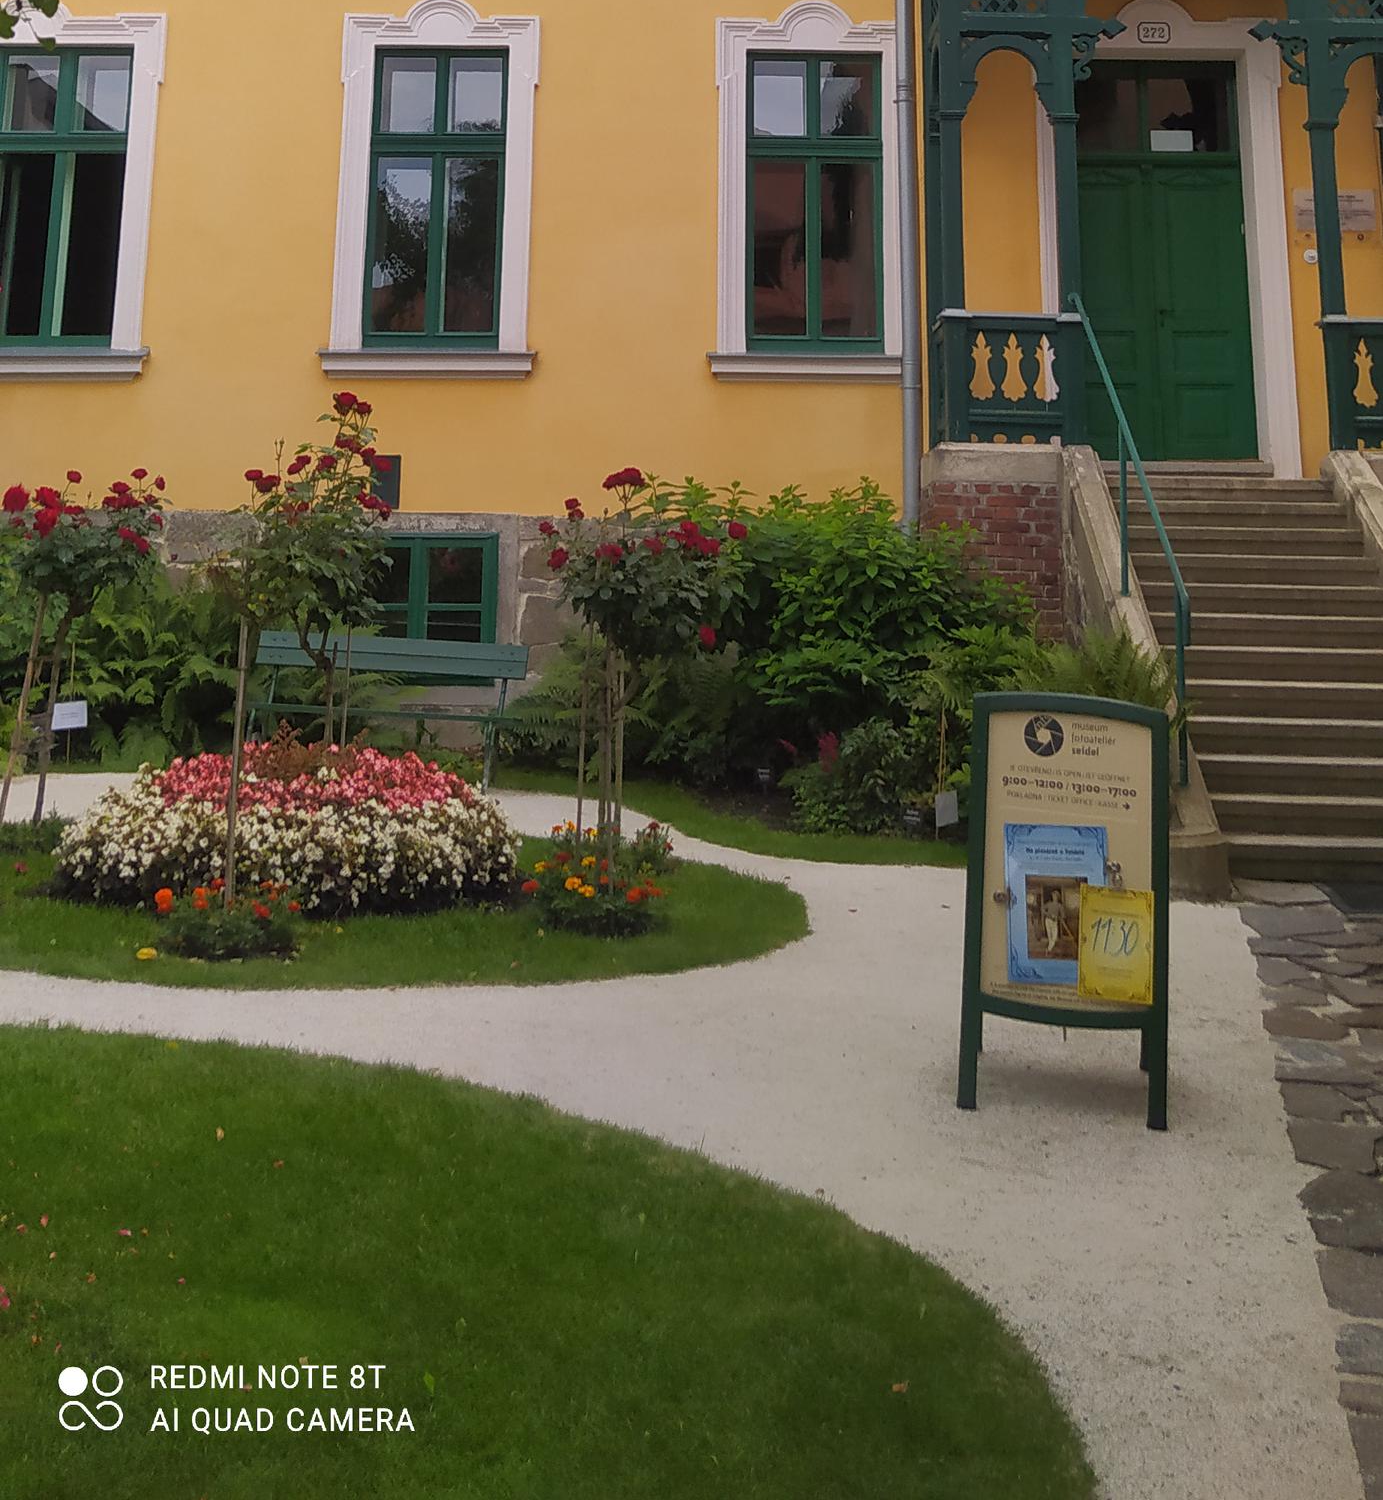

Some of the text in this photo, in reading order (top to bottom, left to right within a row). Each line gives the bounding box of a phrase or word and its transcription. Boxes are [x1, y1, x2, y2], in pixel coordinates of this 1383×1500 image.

[1142, 26, 1165, 39] 272
[1071, 722, 1109, 732] museum
[1071, 746, 1100, 757] seidel
